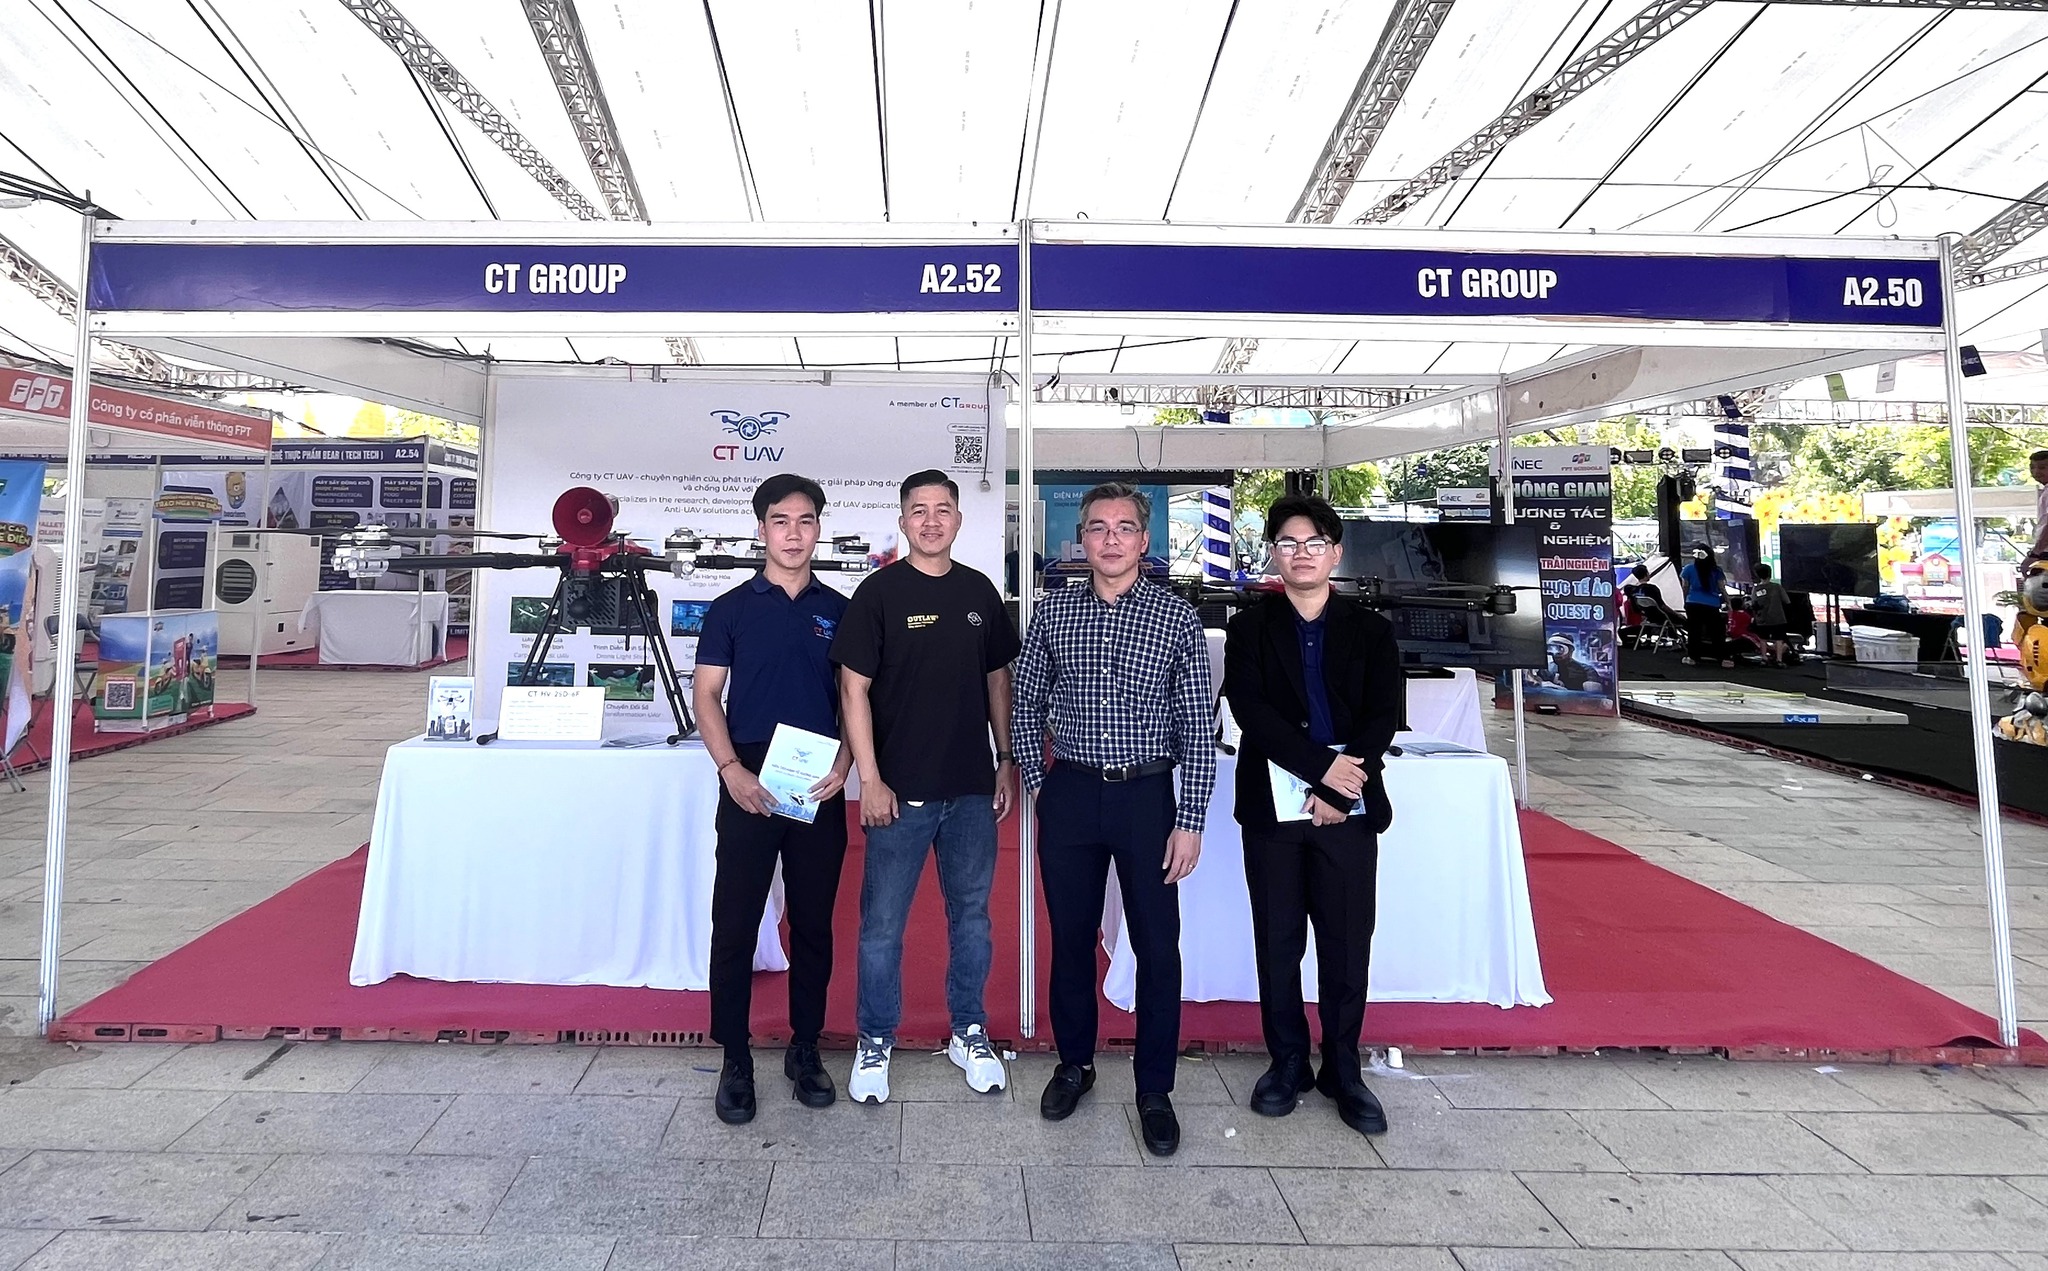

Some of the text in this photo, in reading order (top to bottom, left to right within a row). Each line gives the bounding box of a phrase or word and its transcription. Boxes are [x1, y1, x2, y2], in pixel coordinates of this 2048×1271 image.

[484, 263, 627, 294] CT GROUP
[920, 264, 1001, 292] A2.52
[1418, 268, 1558, 298] CT GROUP
[1843, 277, 1922, 307] A2.50
[9, 377, 64, 410] FPT
[92, 398, 122, 417] Công
[126, 404, 138, 420] ty
[234, 425, 252, 436] FPT
[395, 449, 418, 458] A2.54
[713, 445, 784, 462] CT UAV
[1496, 480, 1559, 498] HÔNG
[1564, 482, 1609, 498] GIAN
[1502, 508, 1566, 518] ƯƠNG
[1570, 506, 1606, 518] TÁC
[1544, 534, 1611, 547] NGHIỆM
[1566, 557, 1609, 572] NGHIỆM
[1542, 580, 1570, 598] HỰC
[1572, 577, 1591, 596] TẾ
[1548, 603, 1604, 620] QUEST 3
